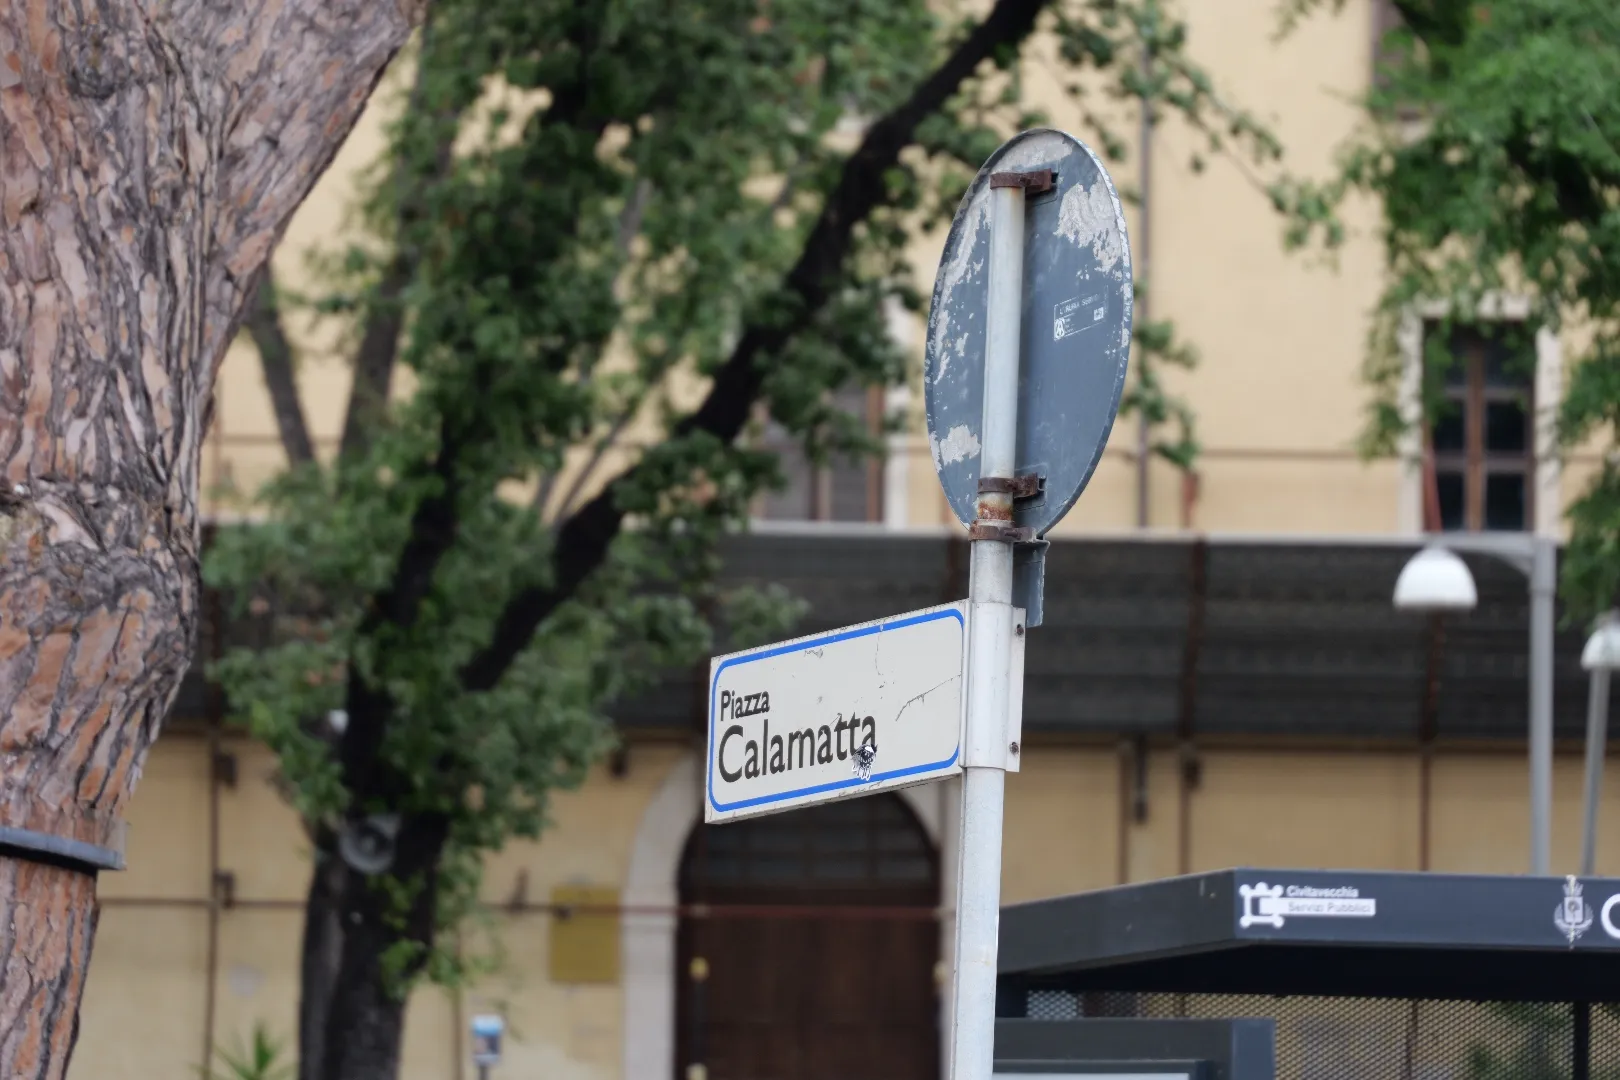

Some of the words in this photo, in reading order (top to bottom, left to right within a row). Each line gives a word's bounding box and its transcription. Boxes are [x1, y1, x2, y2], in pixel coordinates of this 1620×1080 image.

[720, 690, 770, 722] Piazza
[718, 711, 877, 783] Calamatta
[1286, 885, 1359, 898] Civitavecchia
[1288, 901, 1324, 913] Servizi
[1326, 902, 1372, 913] Pubblici
